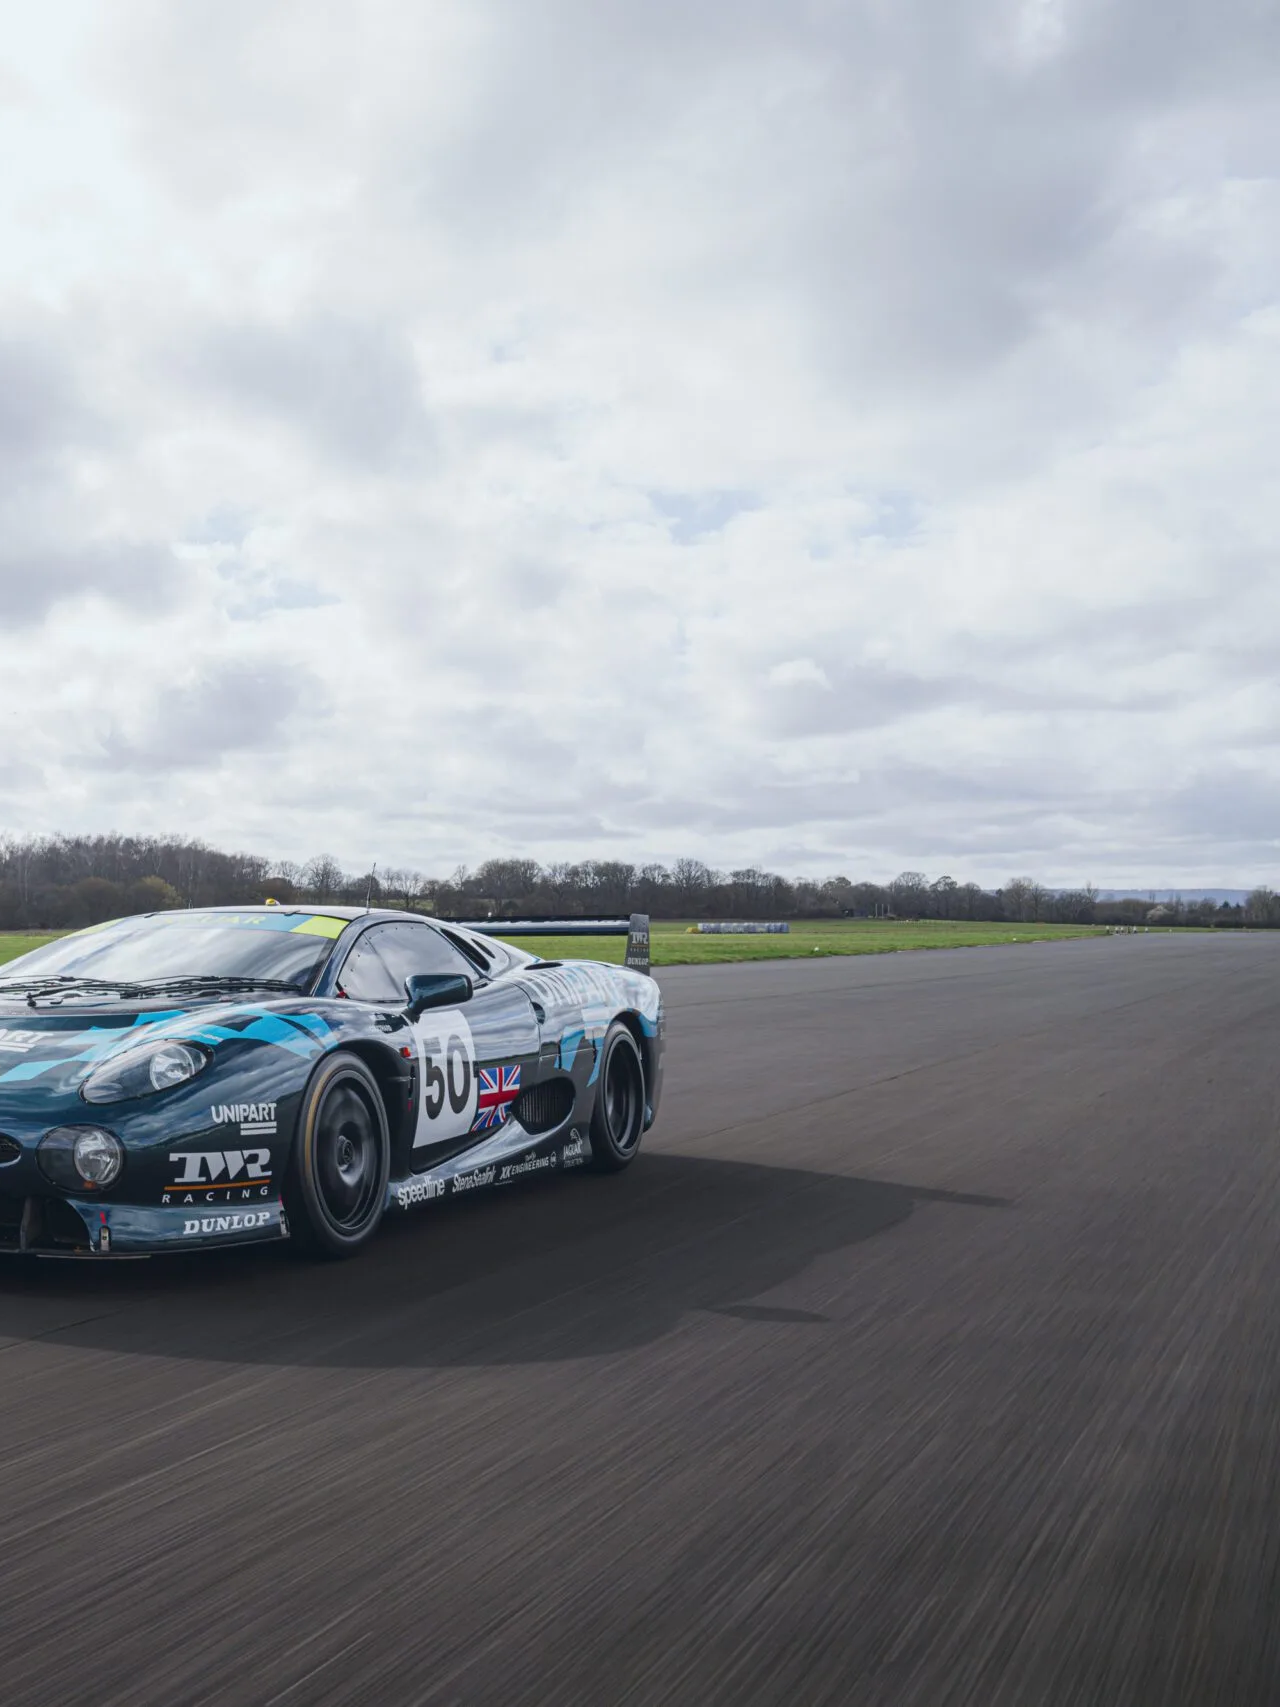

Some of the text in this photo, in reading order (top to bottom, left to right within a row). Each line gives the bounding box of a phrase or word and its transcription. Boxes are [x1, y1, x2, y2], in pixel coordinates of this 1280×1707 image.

[627, 957, 649, 966] DUNLOP
[423, 1034, 471, 1120] 50
[211, 1103, 277, 1123] UNIPART
[169, 1148, 272, 1183] TWR
[161, 1186, 269, 1203] RACING
[183, 1212, 271, 1235] DUNLOP
